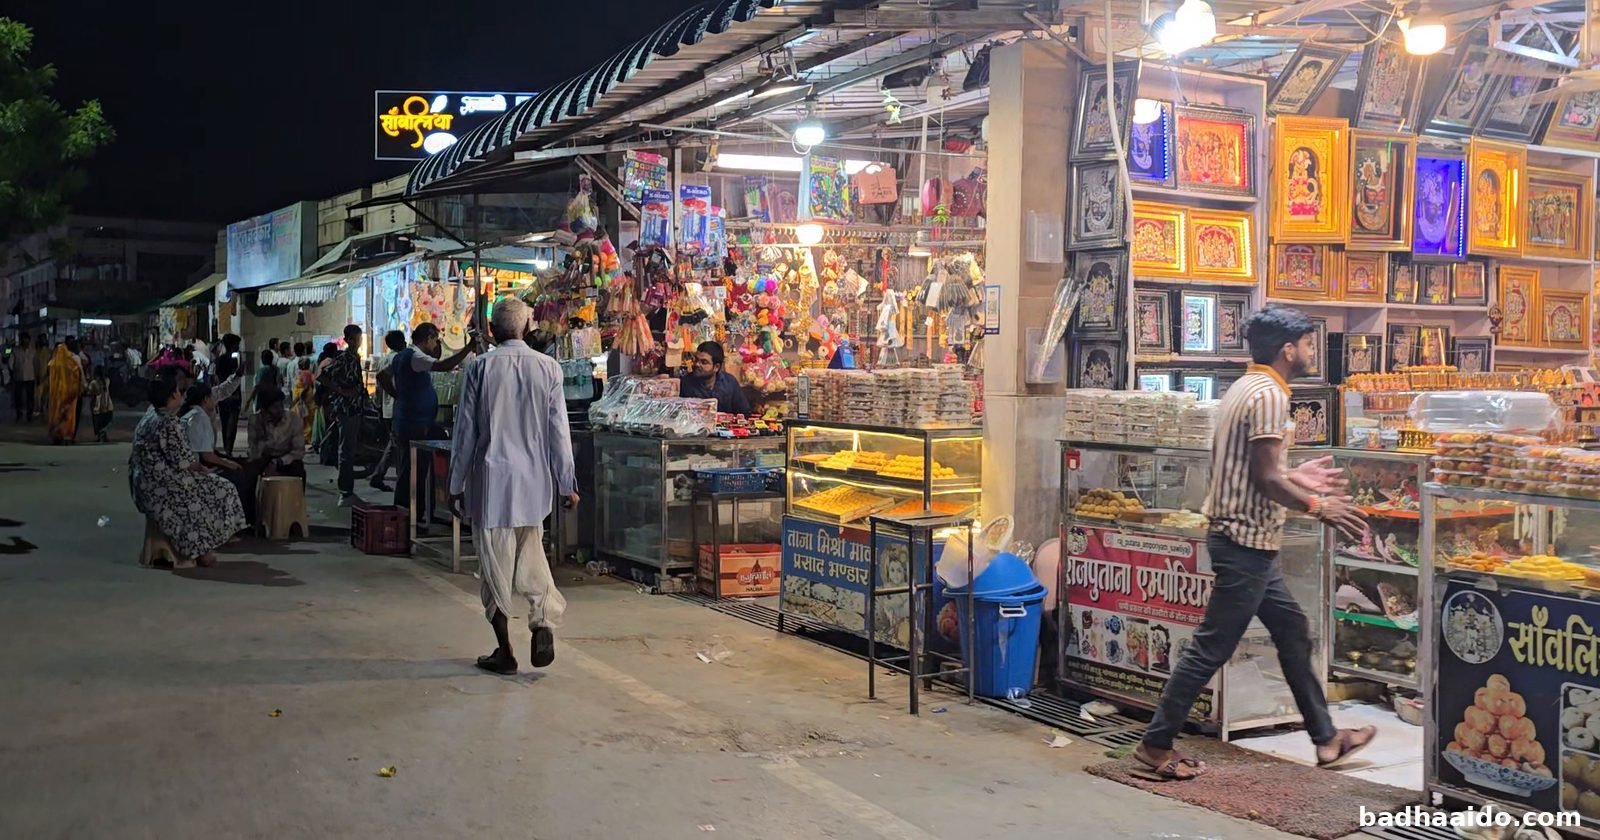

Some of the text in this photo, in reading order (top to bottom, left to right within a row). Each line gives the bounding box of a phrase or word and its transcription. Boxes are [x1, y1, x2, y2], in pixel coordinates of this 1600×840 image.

[787, 529, 813, 551] ताजा
[793, 553, 870, 586] प्रसाद भण्डार
